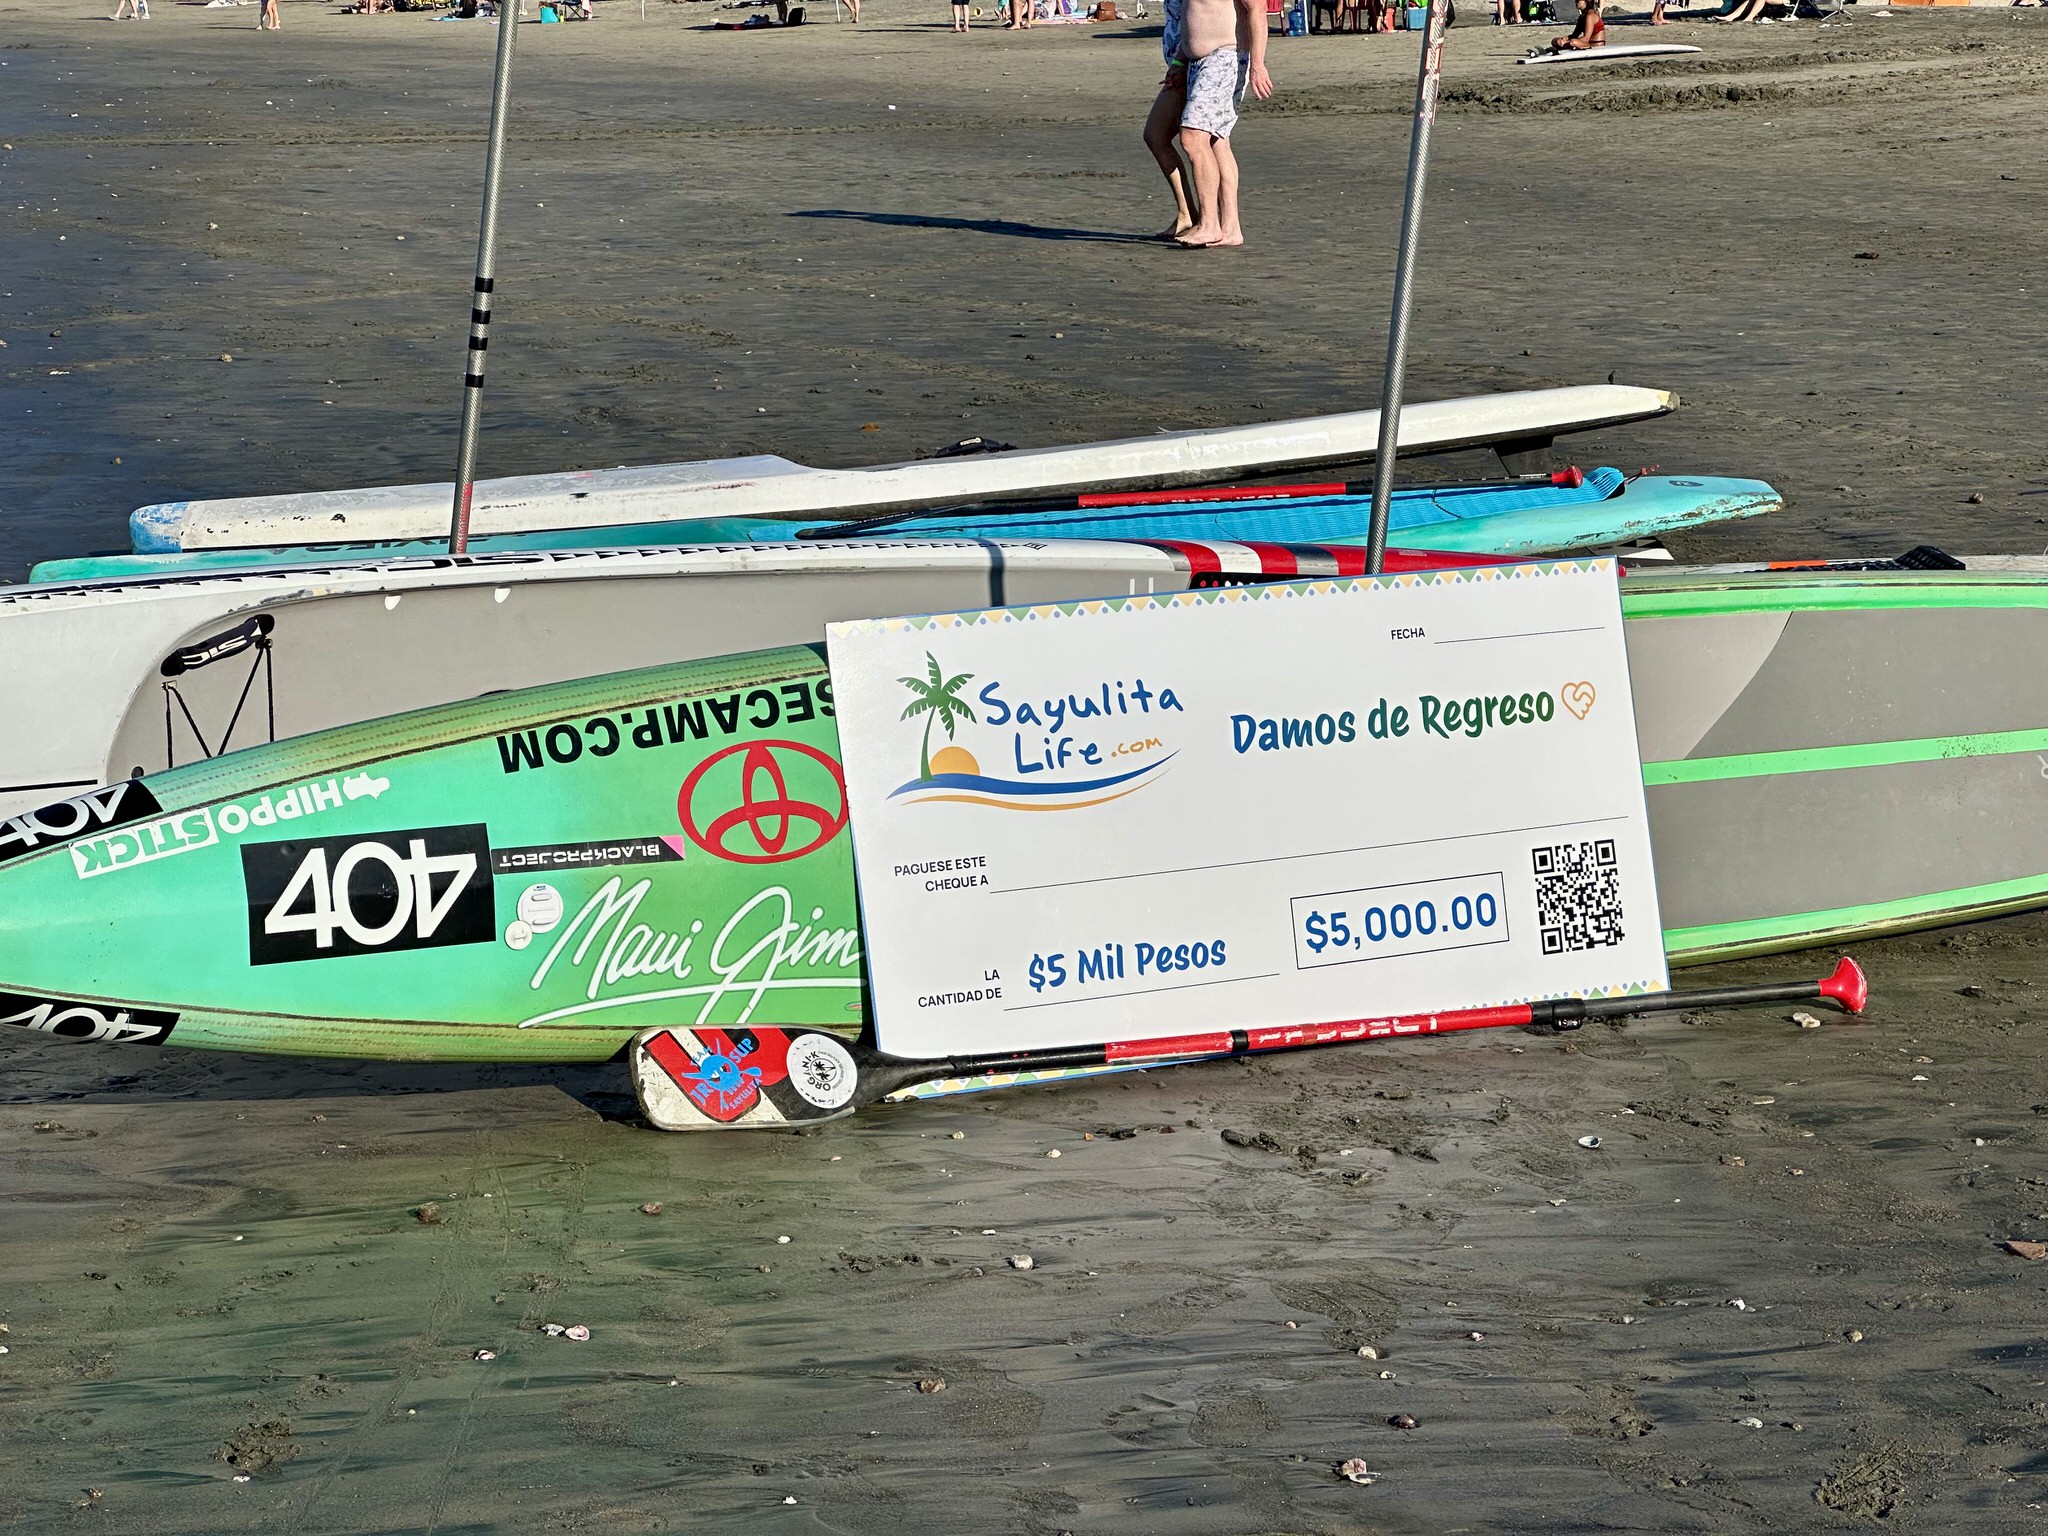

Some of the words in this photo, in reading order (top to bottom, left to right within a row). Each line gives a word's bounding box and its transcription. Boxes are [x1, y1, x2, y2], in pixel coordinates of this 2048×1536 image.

[1391, 627, 1425, 640] FECHA
[979, 679, 1185, 734] Sayulita
[1230, 711, 1356, 754] Damos
[1367, 698, 1409, 739] de
[1419, 691, 1555, 739] Regreso
[219, 779, 344, 834] HIPPO
[75, 817, 211, 873] STICK
[894, 860, 953, 877] PAGUESE
[955, 856, 987, 871] ESTE
[264, 838, 478, 949] 404
[925, 876, 977, 892] CHEQUE
[978, 874, 989, 886] A
[529, 876, 703, 1000] Maui
[696, 884, 864, 1024] Jim
[1305, 892, 1498, 954] $5,000.00
[984, 968, 1000, 981] LA
[1028, 953, 1067, 993] $5
[1078, 944, 1124, 984] Mil
[1135, 939, 1226, 975] Pesos
[918, 990, 983, 1008] CANTIDAD
[986, 987, 1002, 1000] DE
[729, 1037, 753, 1063] SUP
